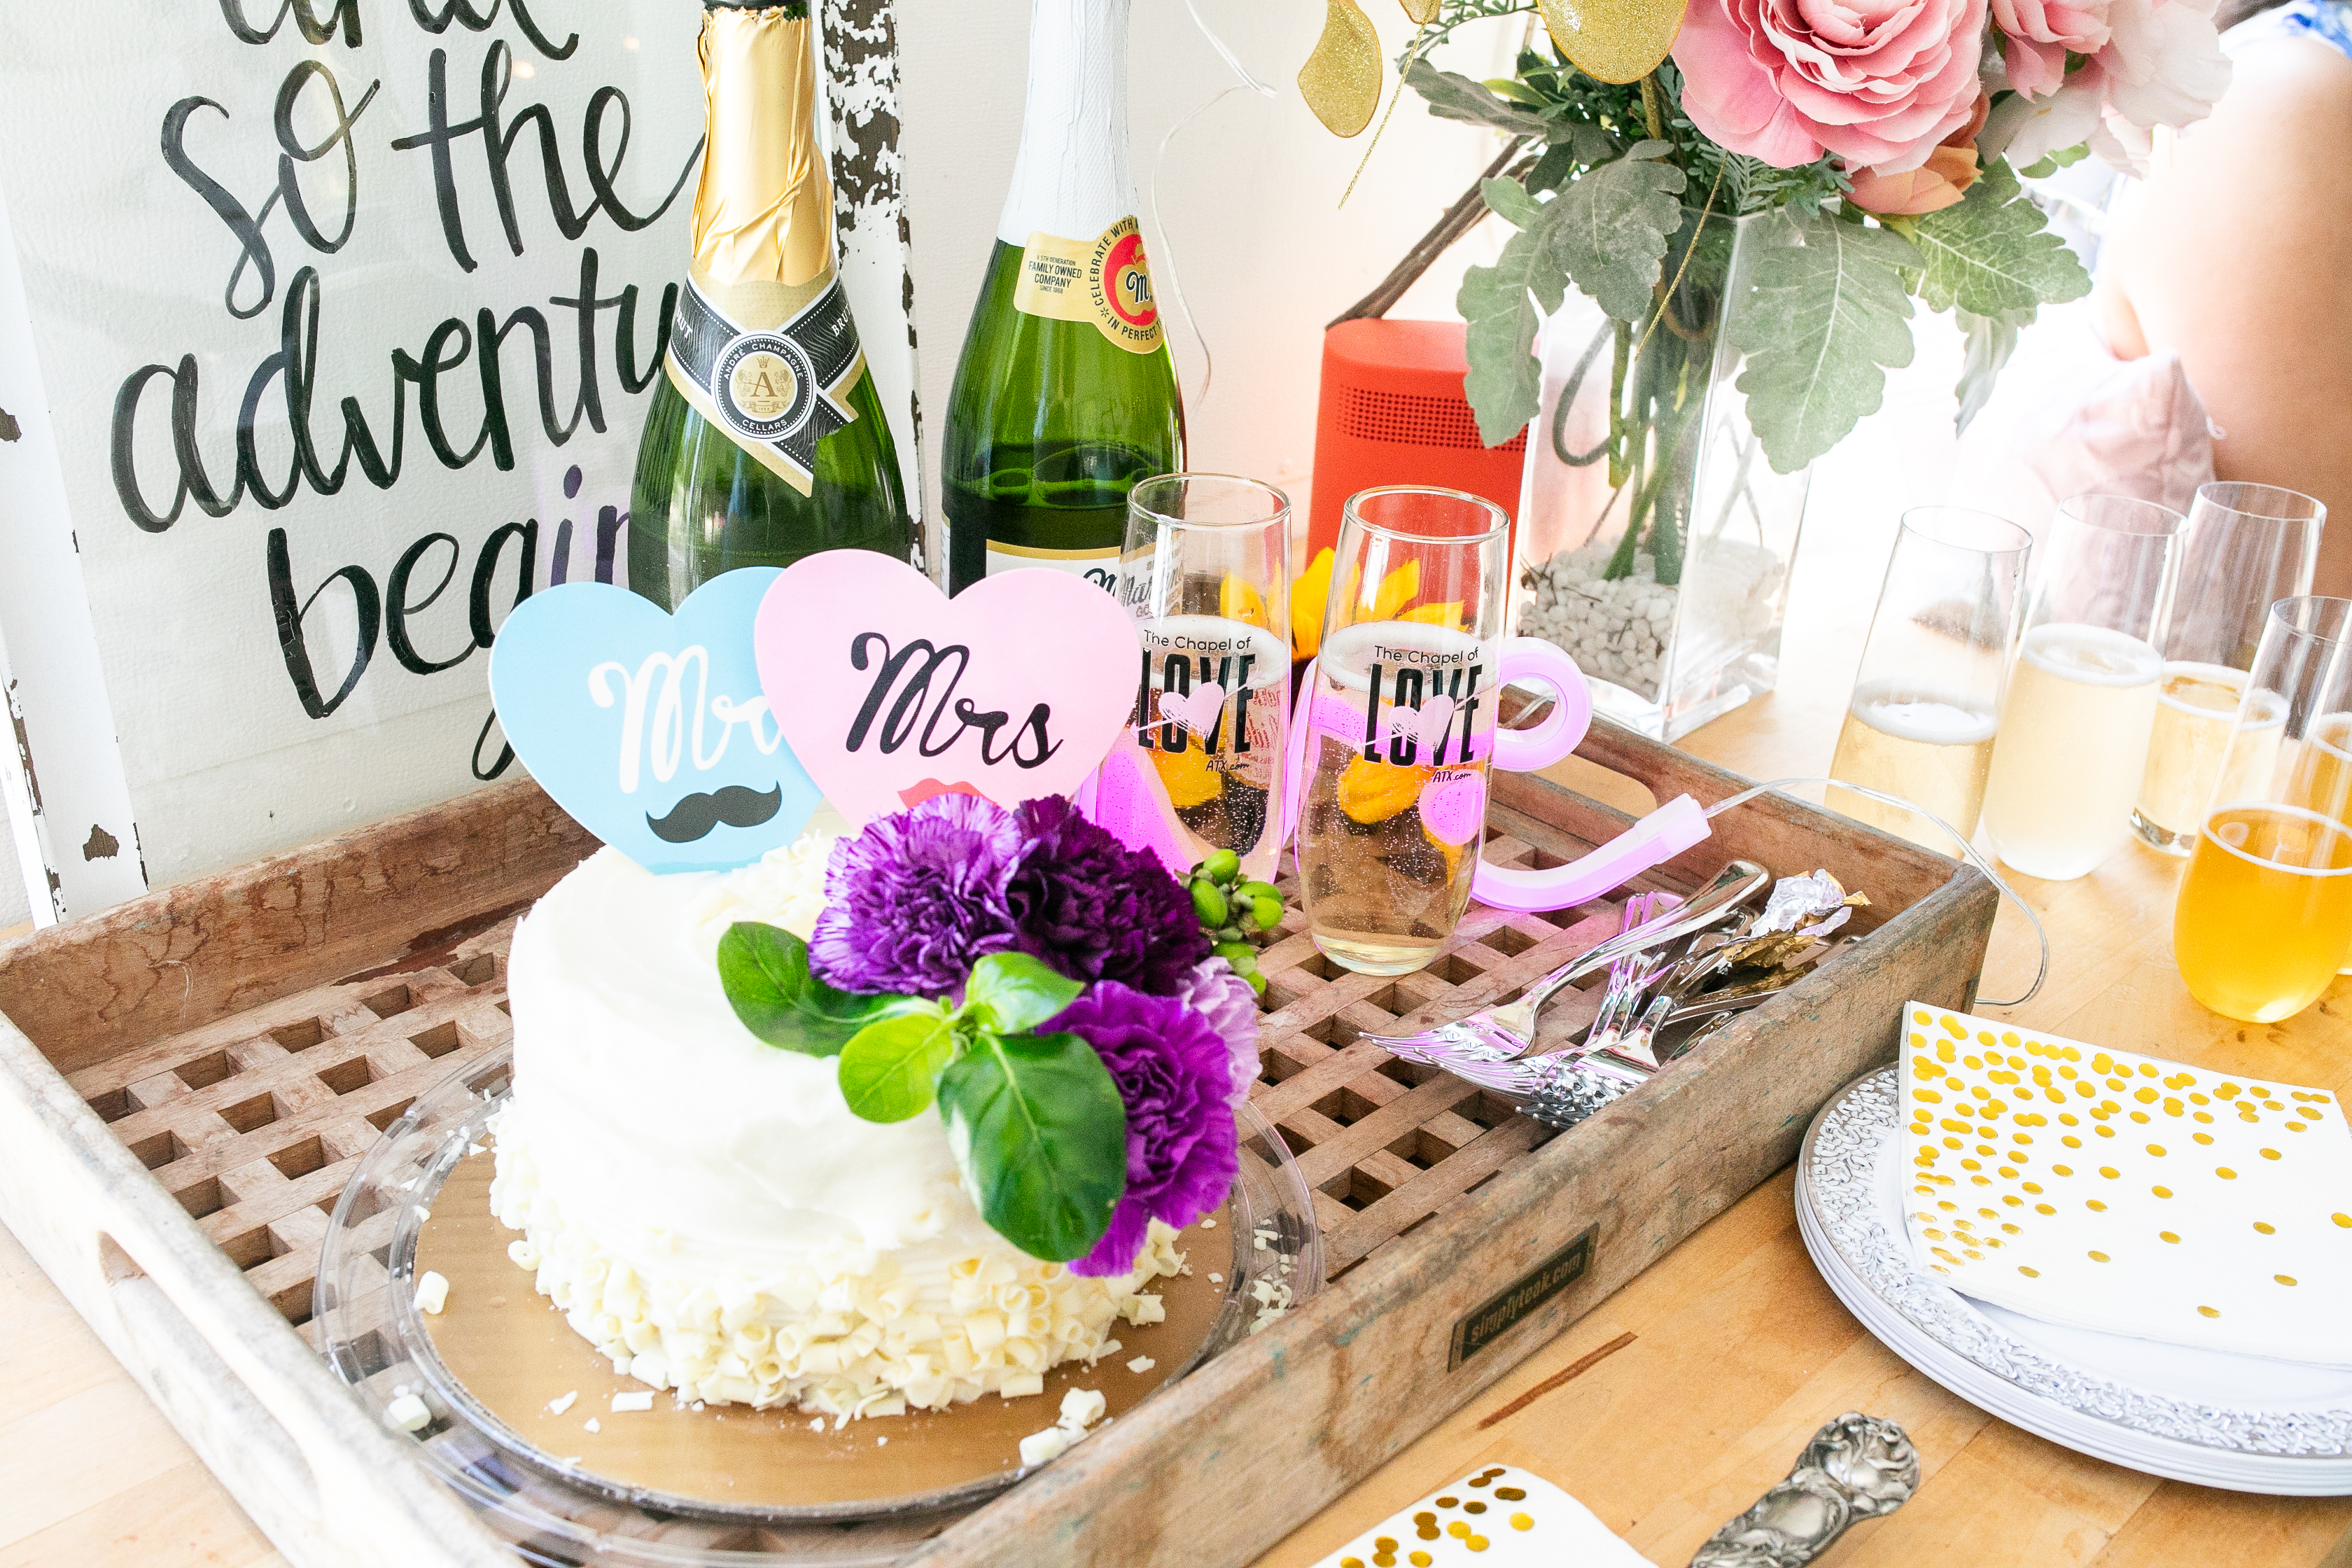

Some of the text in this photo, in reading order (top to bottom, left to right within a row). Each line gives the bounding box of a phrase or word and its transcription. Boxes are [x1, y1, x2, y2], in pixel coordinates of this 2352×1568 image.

[161, 39, 704, 319] so the
[1028, 260, 1082, 279] FAMILY OWNED
[1050, 256, 1077, 266] GENERATION
[1089, 218, 1133, 307] CELEBRATE WITH
[1034, 273, 1072, 288] COMPANY
[831, 302, 850, 337] BRUT
[1107, 316, 1158, 341] IN PERFECT
[751, 342, 804, 379] CHAMPAGNE
[111, 246, 680, 533] adventu
[742, 419, 788, 431] CELLARS
[1144, 629, 1252, 654] The Chapel of
[1373, 645, 1479, 666] The Chapel of
[589, 644, 783, 794] Mr
[846, 632, 1064, 769] Mrs
[1138, 647, 1256, 755] LOVE
[1364, 663, 1483, 767] LOVE
[1471, 1252, 1582, 1343] simplyteak.com
